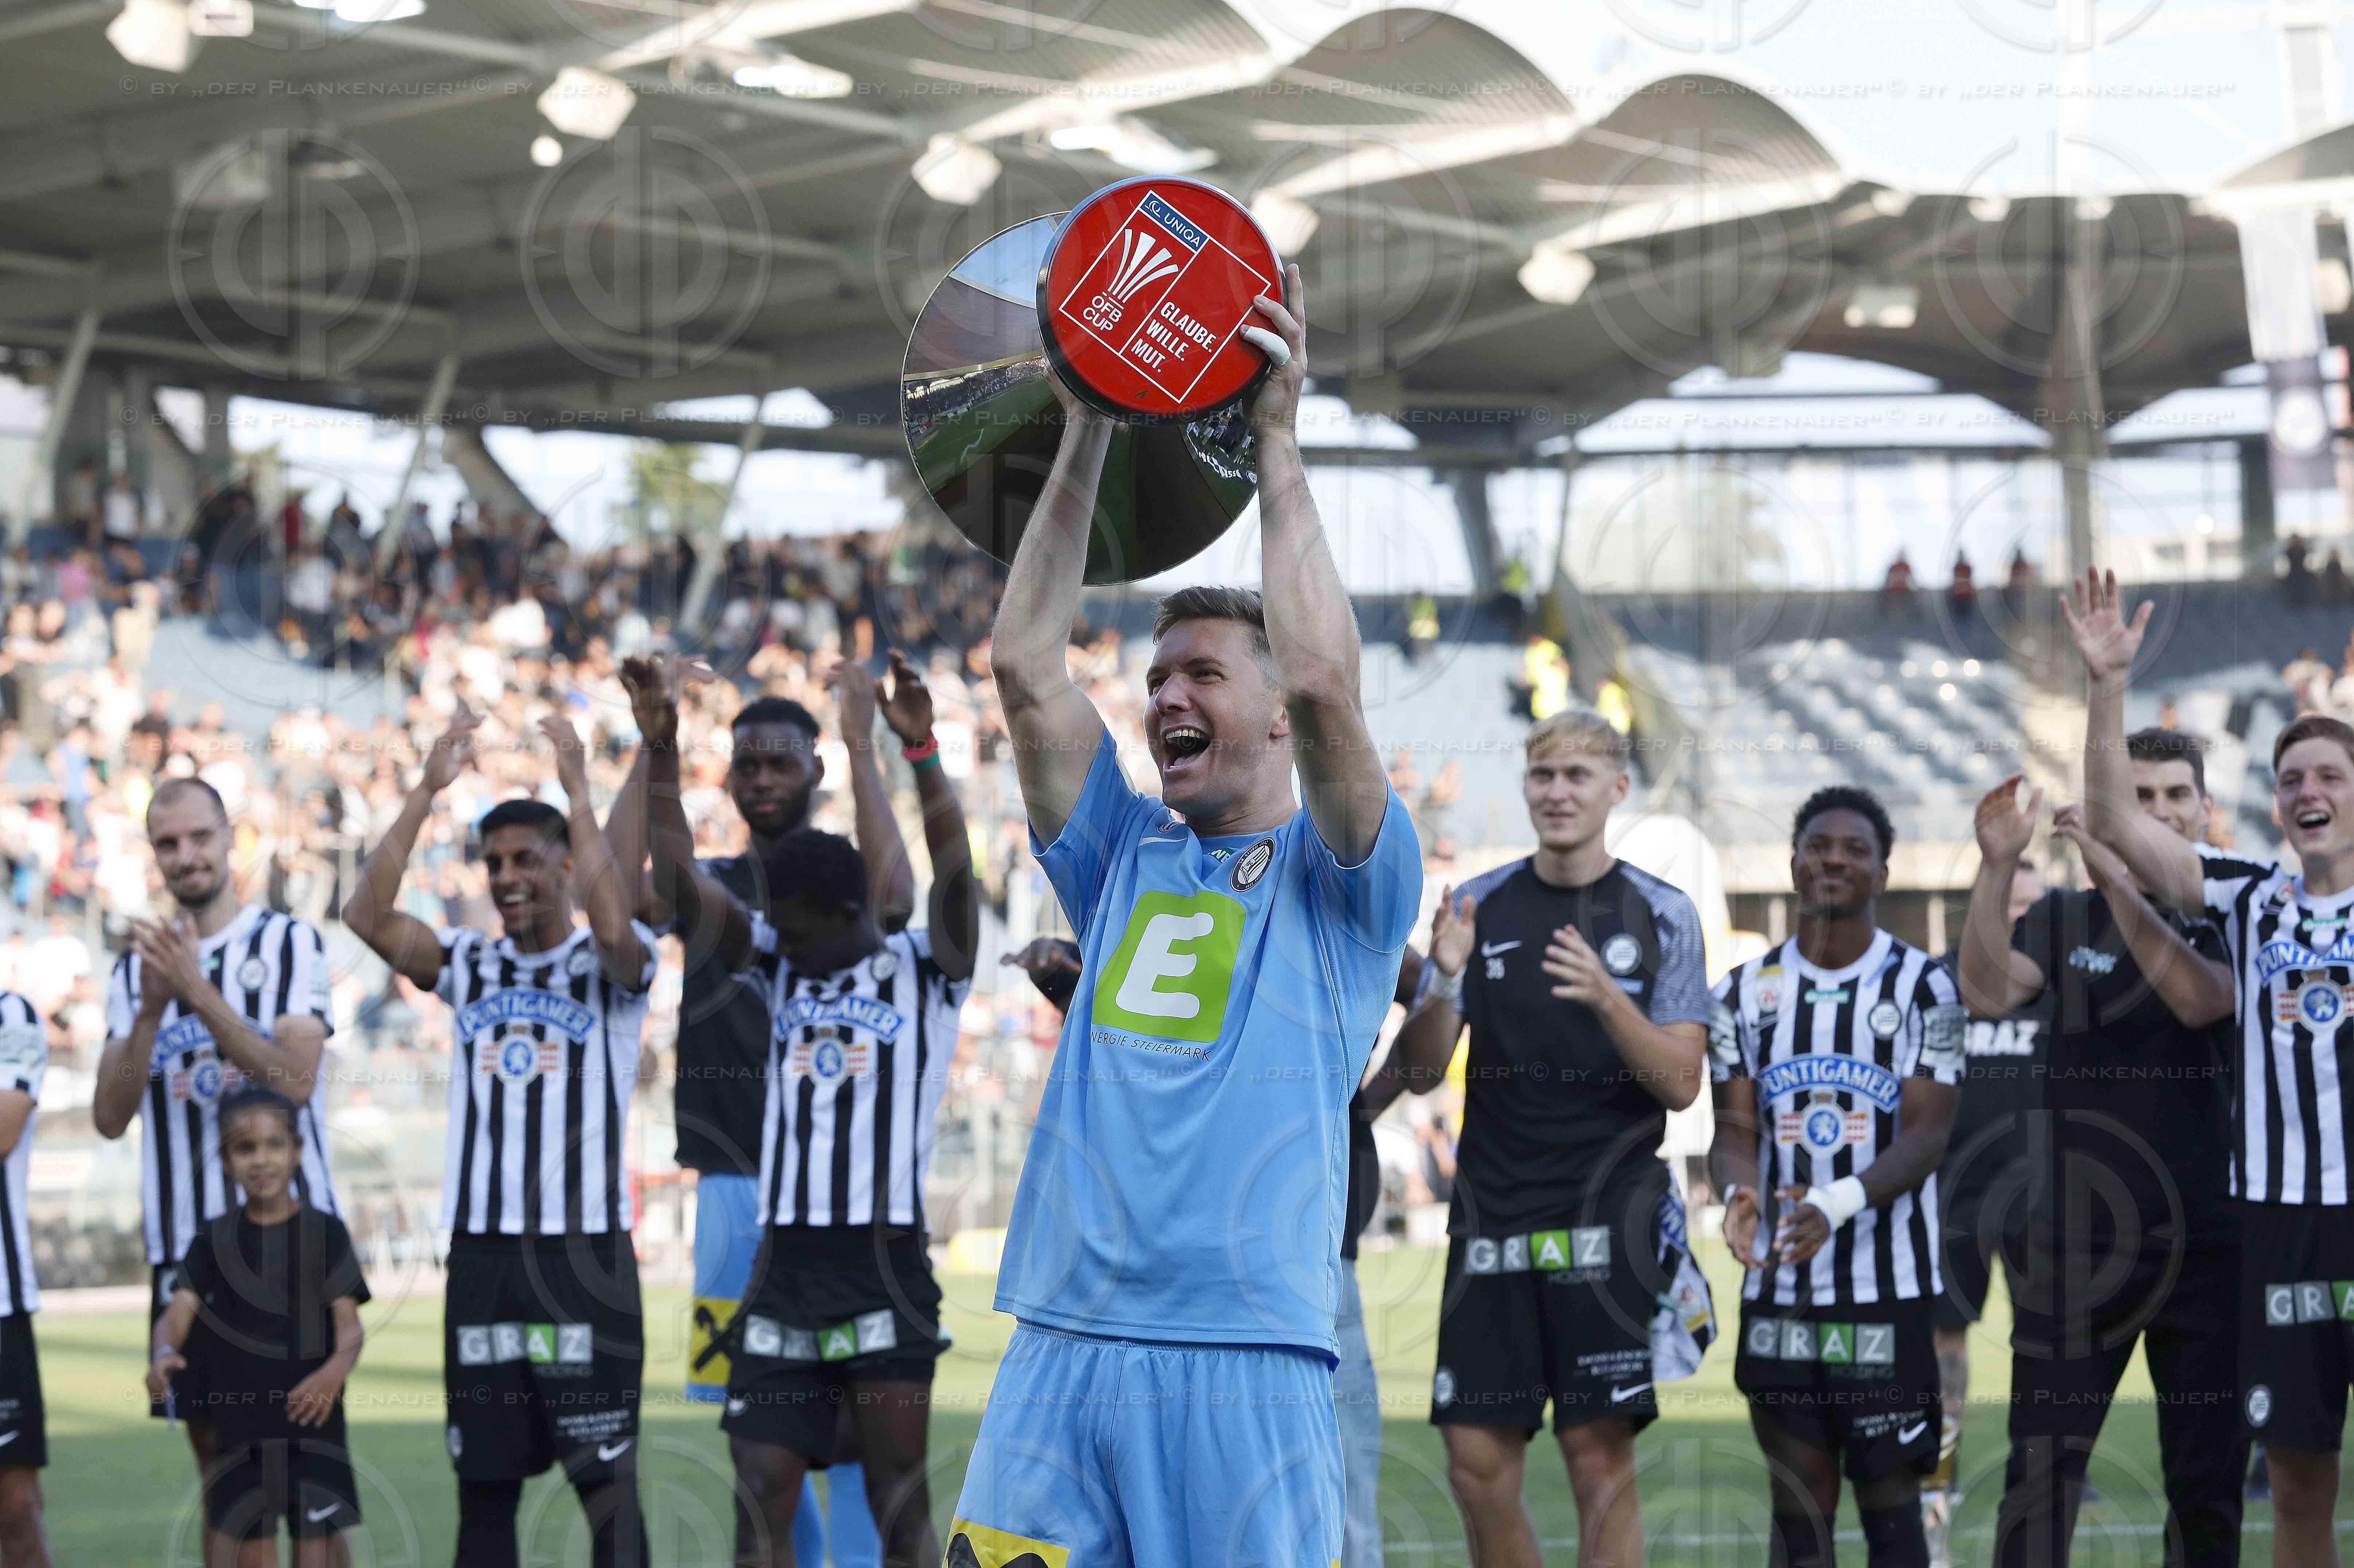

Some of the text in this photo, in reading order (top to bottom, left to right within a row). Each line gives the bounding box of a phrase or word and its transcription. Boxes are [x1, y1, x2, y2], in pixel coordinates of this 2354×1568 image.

[1164, 213, 1201, 247] UNIQA
[1083, 307, 1113, 331] CUP
[1160, 302, 1217, 353] GLAUBE.
[1131, 338, 1166, 373] MUT.
[1146, 319, 1189, 361] WILLE.
[1115, 912, 1214, 1019] E
[1091, 1031, 1211, 1062] NERGIE STEIERMARK
[1468, 1230, 1607, 1272] GRAZ
[459, 1325, 588, 1362] GRAZ
[1749, 1323, 1888, 1363] GRAZ
